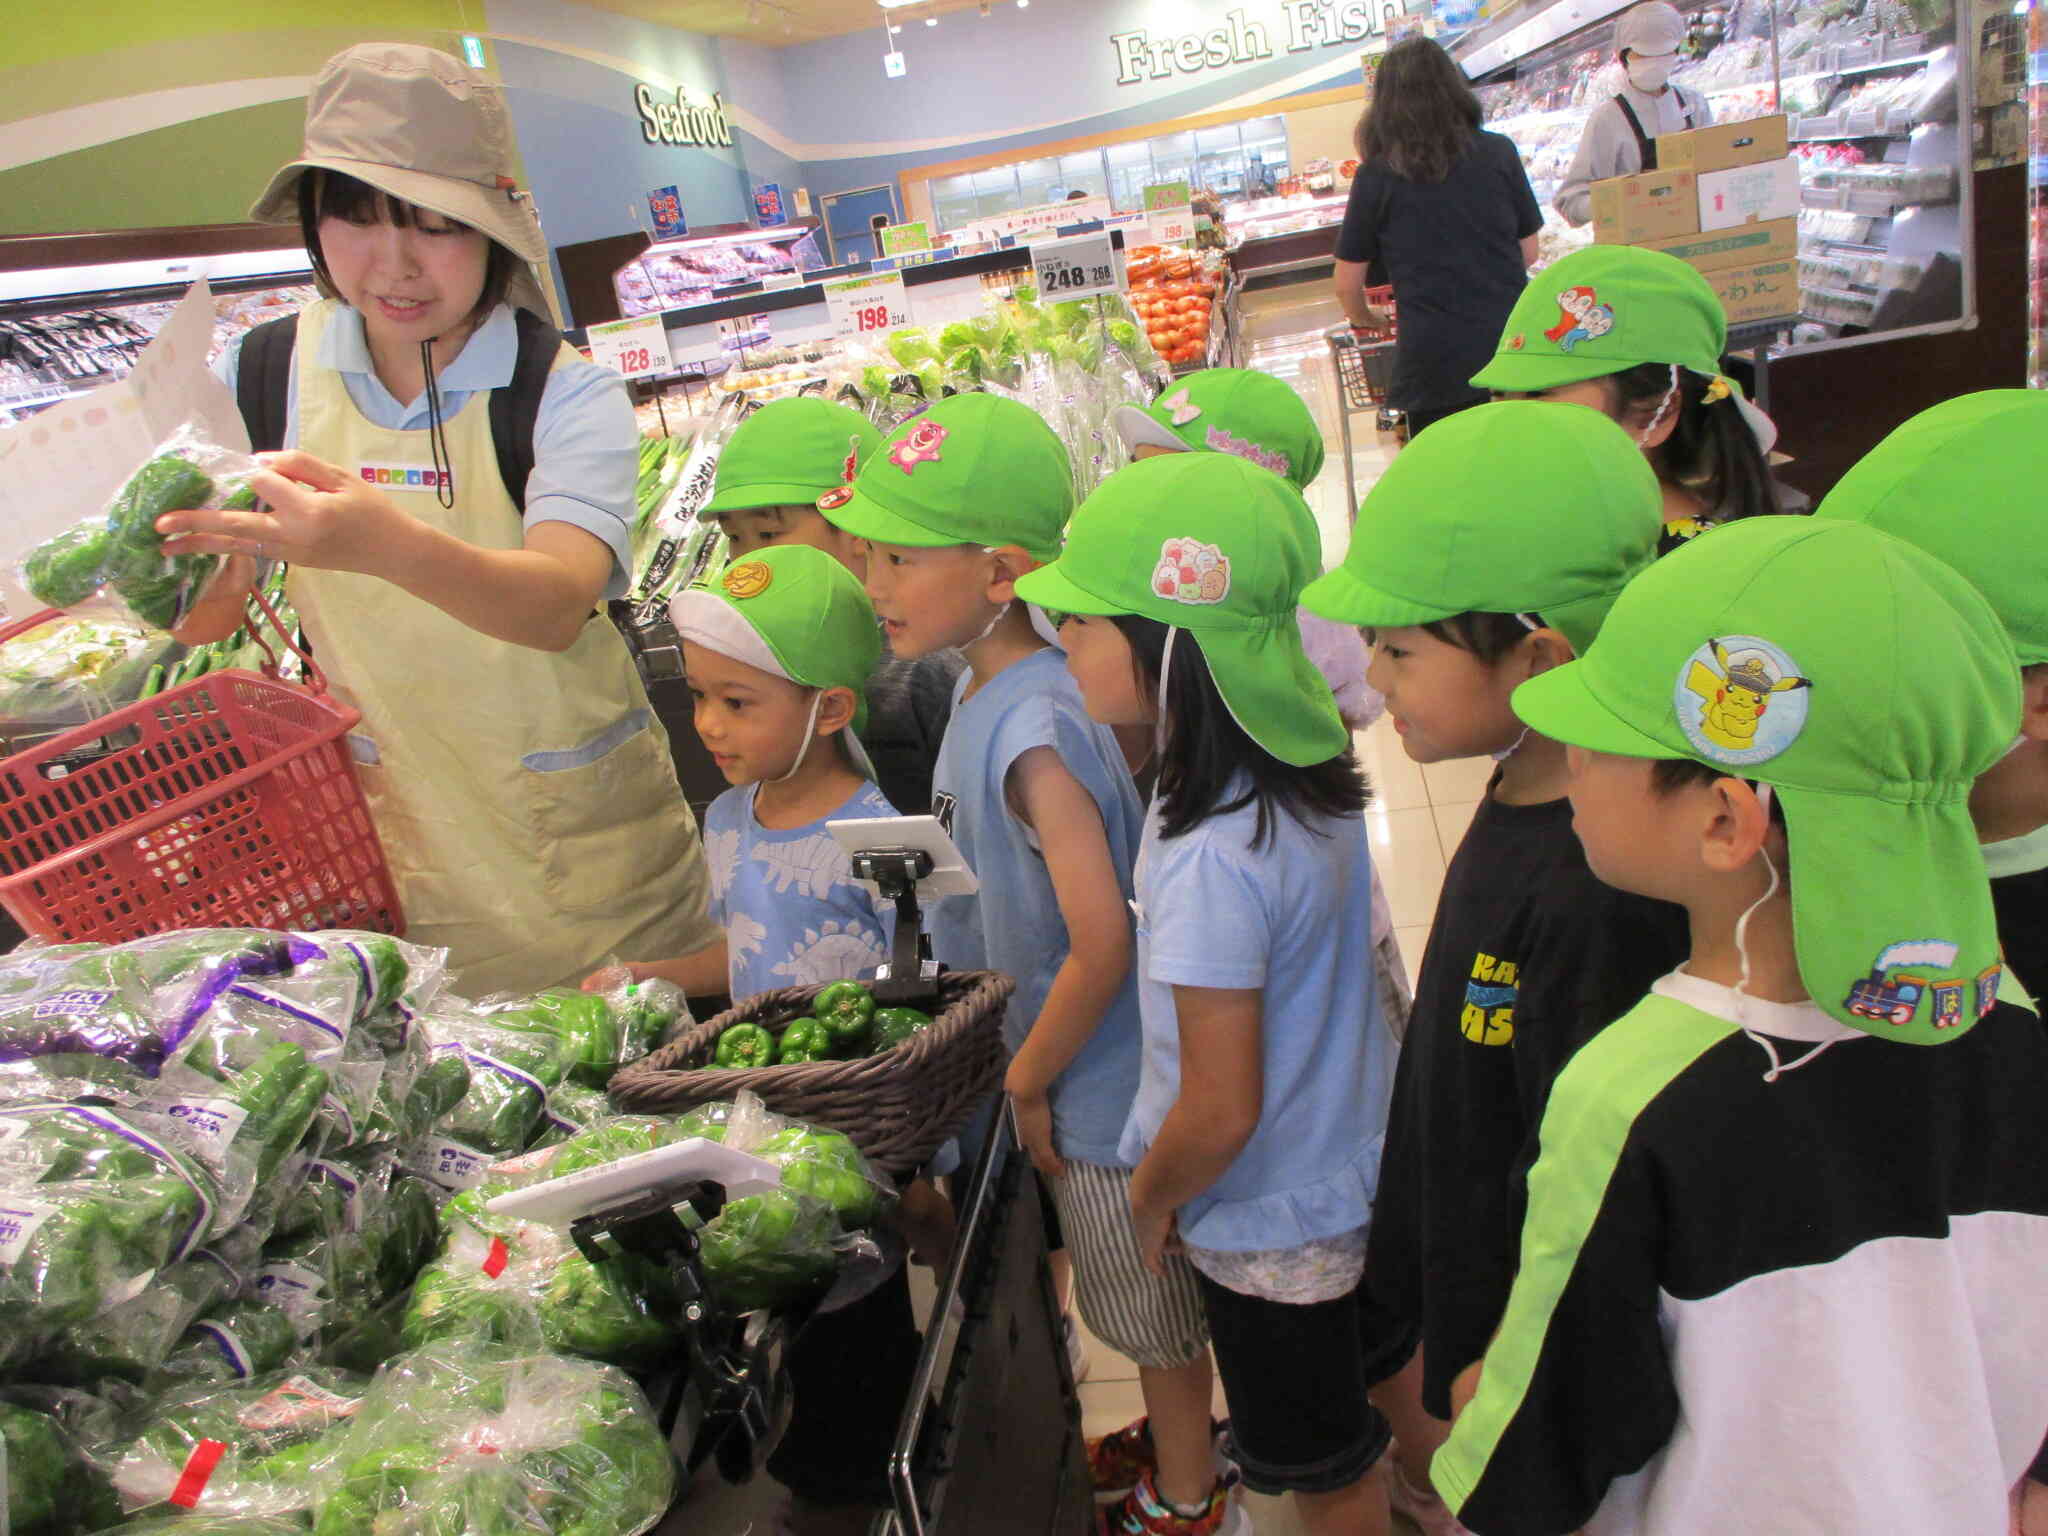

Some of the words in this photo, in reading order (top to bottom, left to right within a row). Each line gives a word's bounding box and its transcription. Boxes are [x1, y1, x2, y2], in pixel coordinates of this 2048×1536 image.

[1111, 8, 1272, 85] Fresh
[1283, 0, 1407, 52] Fish
[634, 83, 733, 147] Seafood
[1044, 267, 1085, 291] 248
[856, 305, 888, 332] 198
[619, 348, 649, 373] 128
